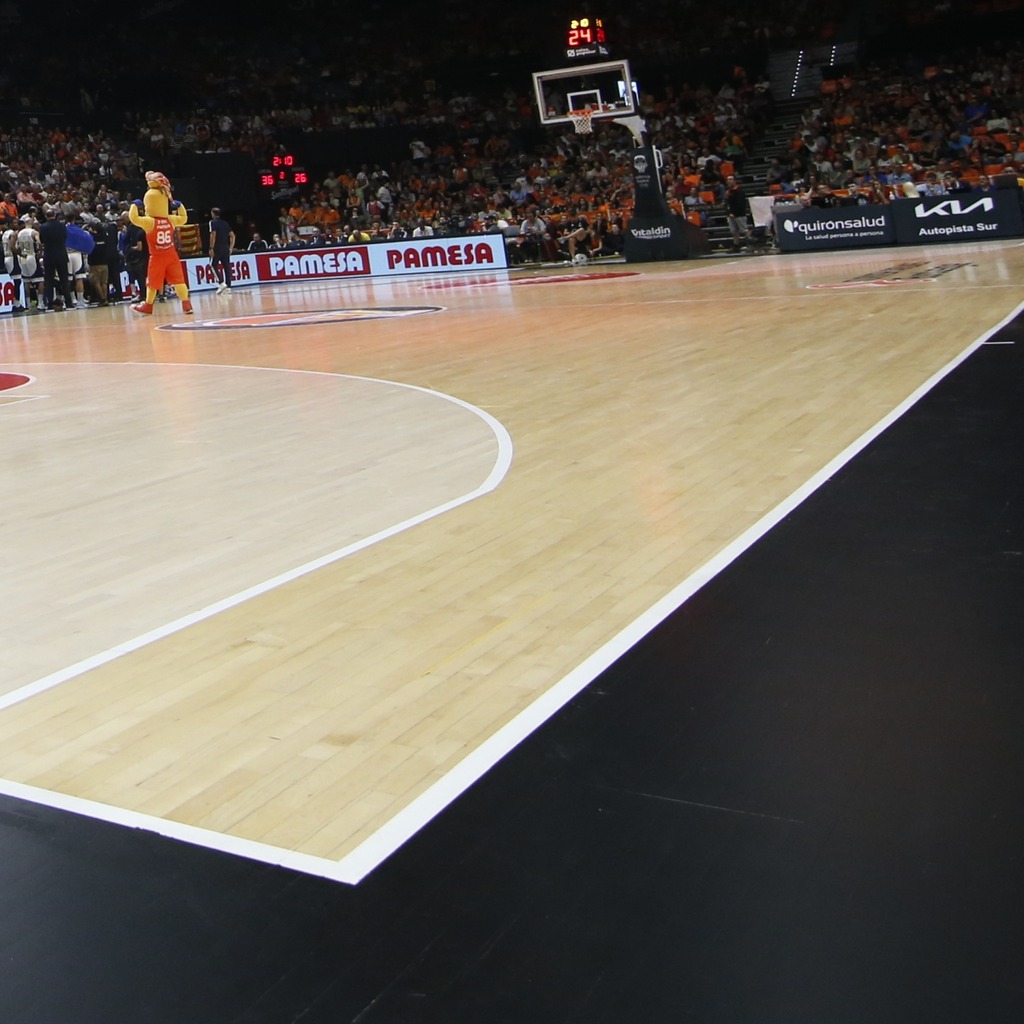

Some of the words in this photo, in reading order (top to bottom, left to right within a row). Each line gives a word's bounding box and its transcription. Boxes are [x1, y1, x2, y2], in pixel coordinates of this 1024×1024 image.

[569, 28, 591, 45] 24
[261, 175, 274, 185] 36
[294, 173, 307, 183] 26
[631, 226, 671, 237] Vitaldin
[830, 232, 853, 240] persona
[858, 230, 883, 238] persona
[918, 224, 974, 237] Autopista
[977, 222, 998, 231] Sur
[157, 231, 171, 244] 86
[387, 242, 494, 269] PAMESA
[268, 251, 364, 277] PAMESA
